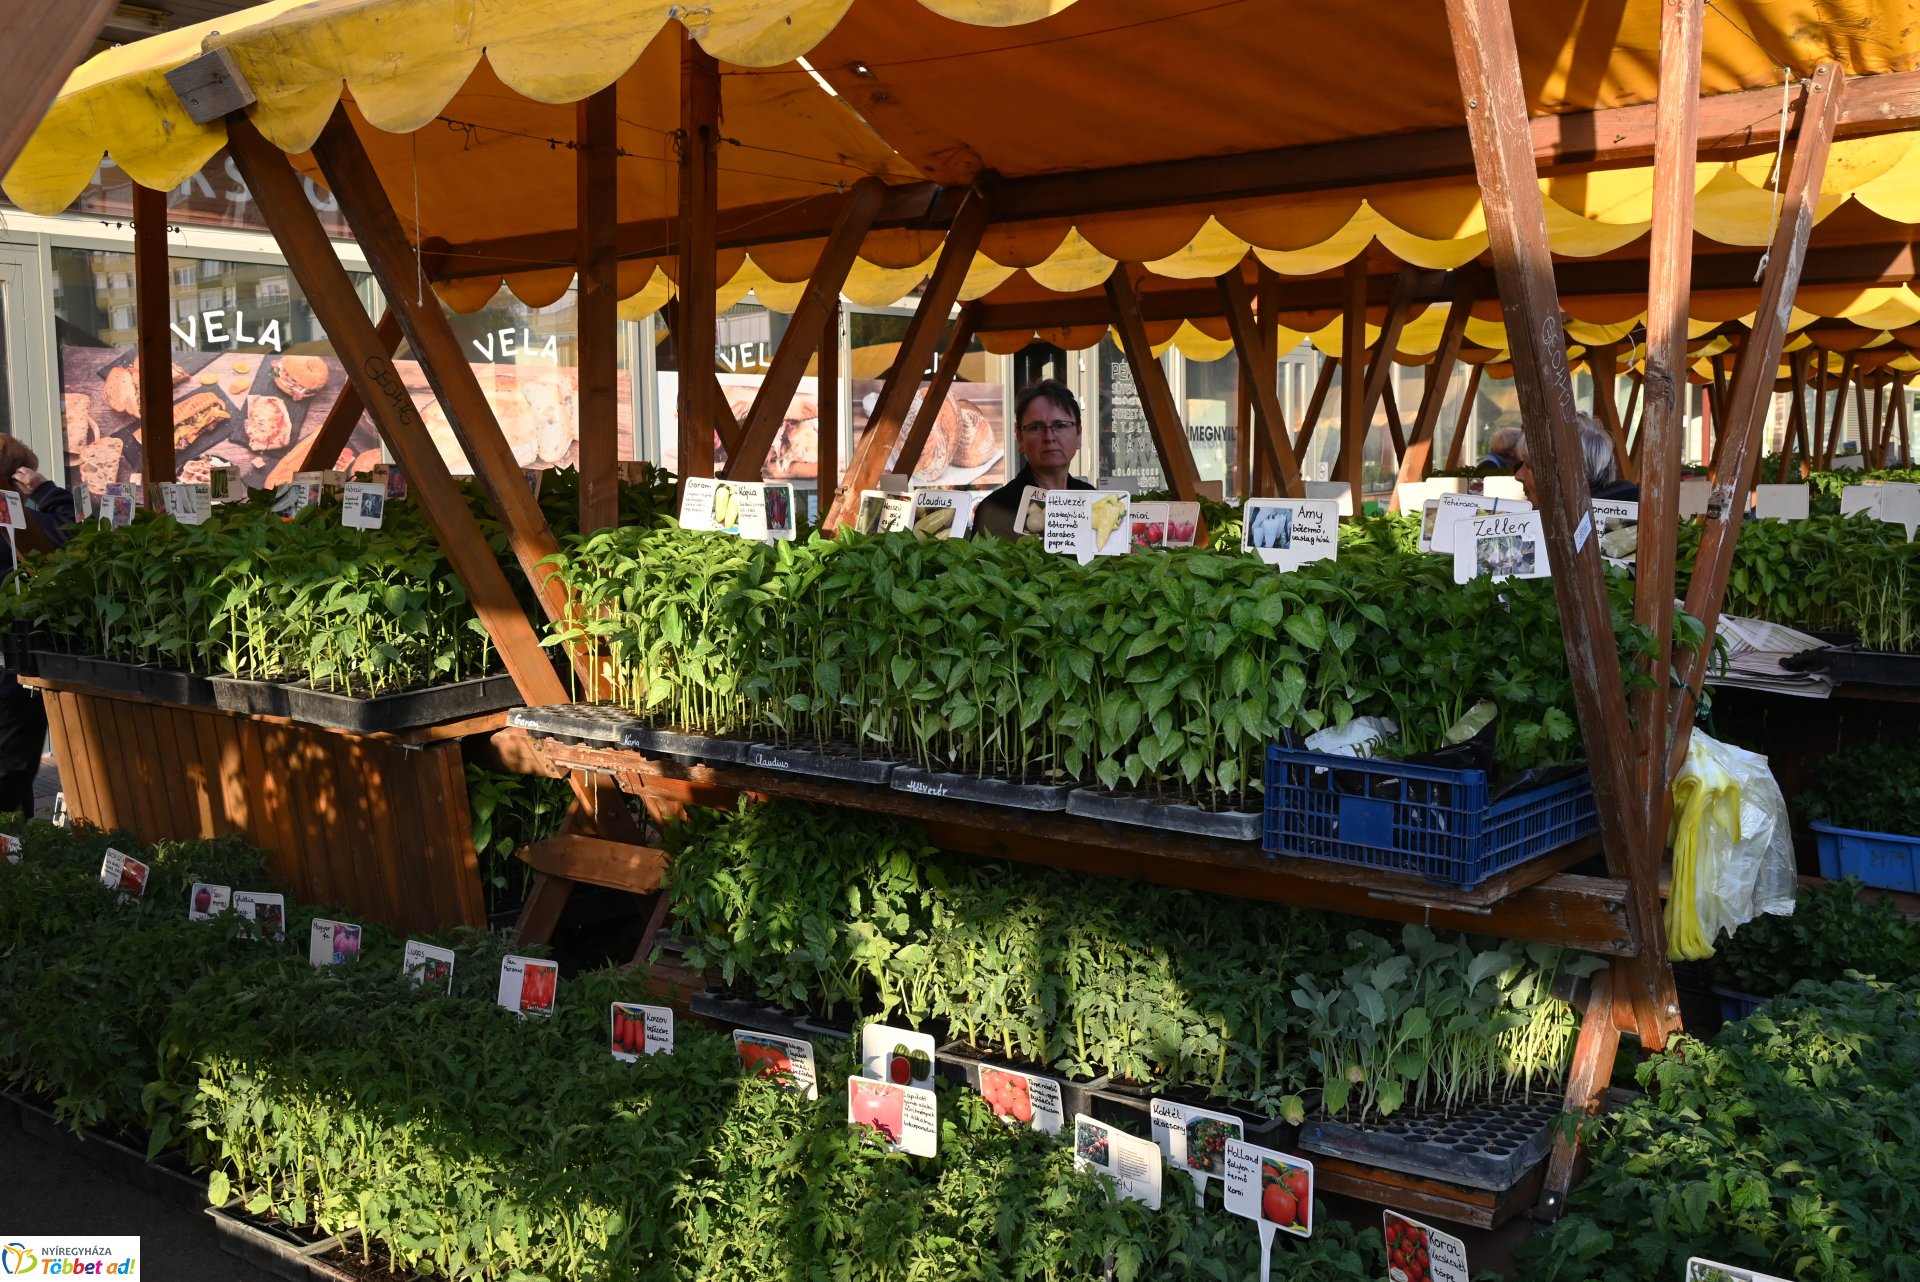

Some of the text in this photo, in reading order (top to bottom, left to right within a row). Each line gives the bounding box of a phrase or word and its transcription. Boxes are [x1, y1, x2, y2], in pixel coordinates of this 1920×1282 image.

[170, 310, 281, 352] VELA
[473, 328, 557, 363] VELA
[720, 342, 771, 372] VEL
[738, 486, 757, 500] Kápia
[917, 493, 953, 508] Claudius
[1047, 496, 1086, 507] Hétvezér
[1297, 505, 1323, 525] Amy
[1046, 530, 1076, 539] darabos
[1473, 517, 1530, 537] Zeller
[1048, 539, 1076, 549] paprika
[755, 753, 789, 768] Claudius
[313, 922, 331, 934] Magyar
[407, 944, 425, 960] Lugas
[1153, 1104, 1183, 1120] Koktél
[1153, 1117, 1187, 1136] alacsony
[1227, 1144, 1260, 1165] Holland
[1227, 1185, 1244, 1197] Korai
[1428, 1230, 1461, 1257] Korai
